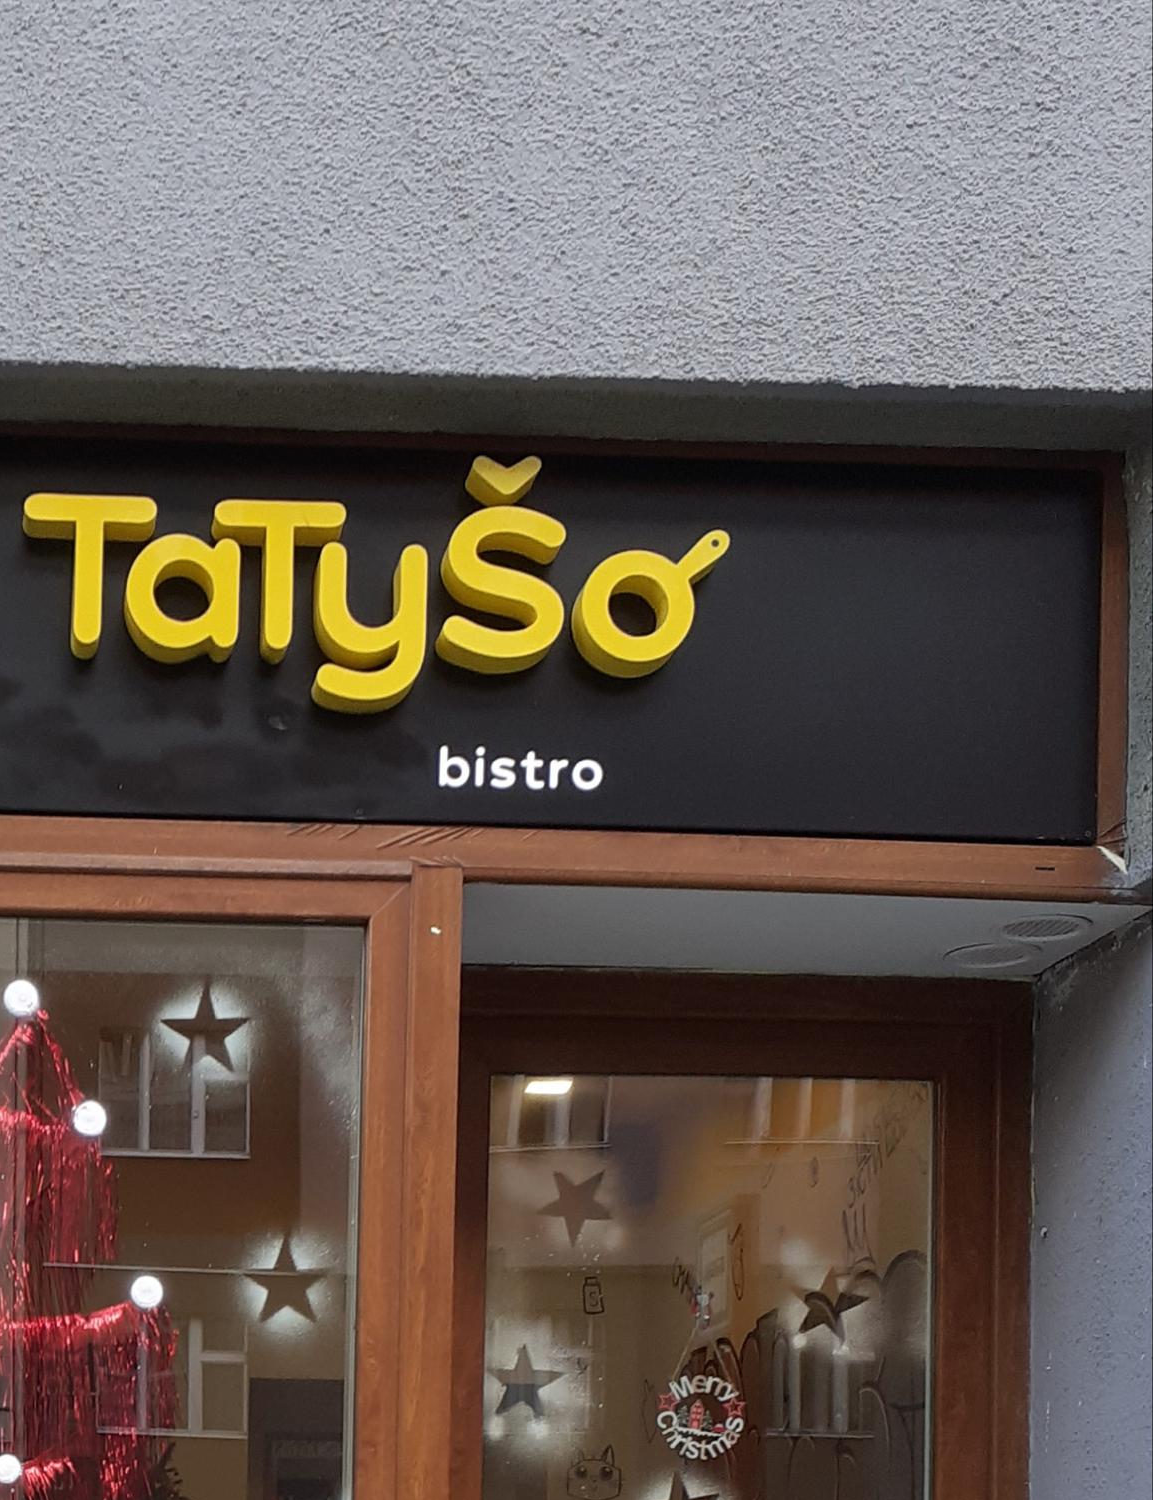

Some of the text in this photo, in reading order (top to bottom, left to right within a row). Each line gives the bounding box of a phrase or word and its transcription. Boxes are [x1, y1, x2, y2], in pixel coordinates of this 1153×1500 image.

[437, 745, 604, 791] bistro
[668, 1375, 739, 1401] Merry
[656, 1410, 745, 1461] Christmas
